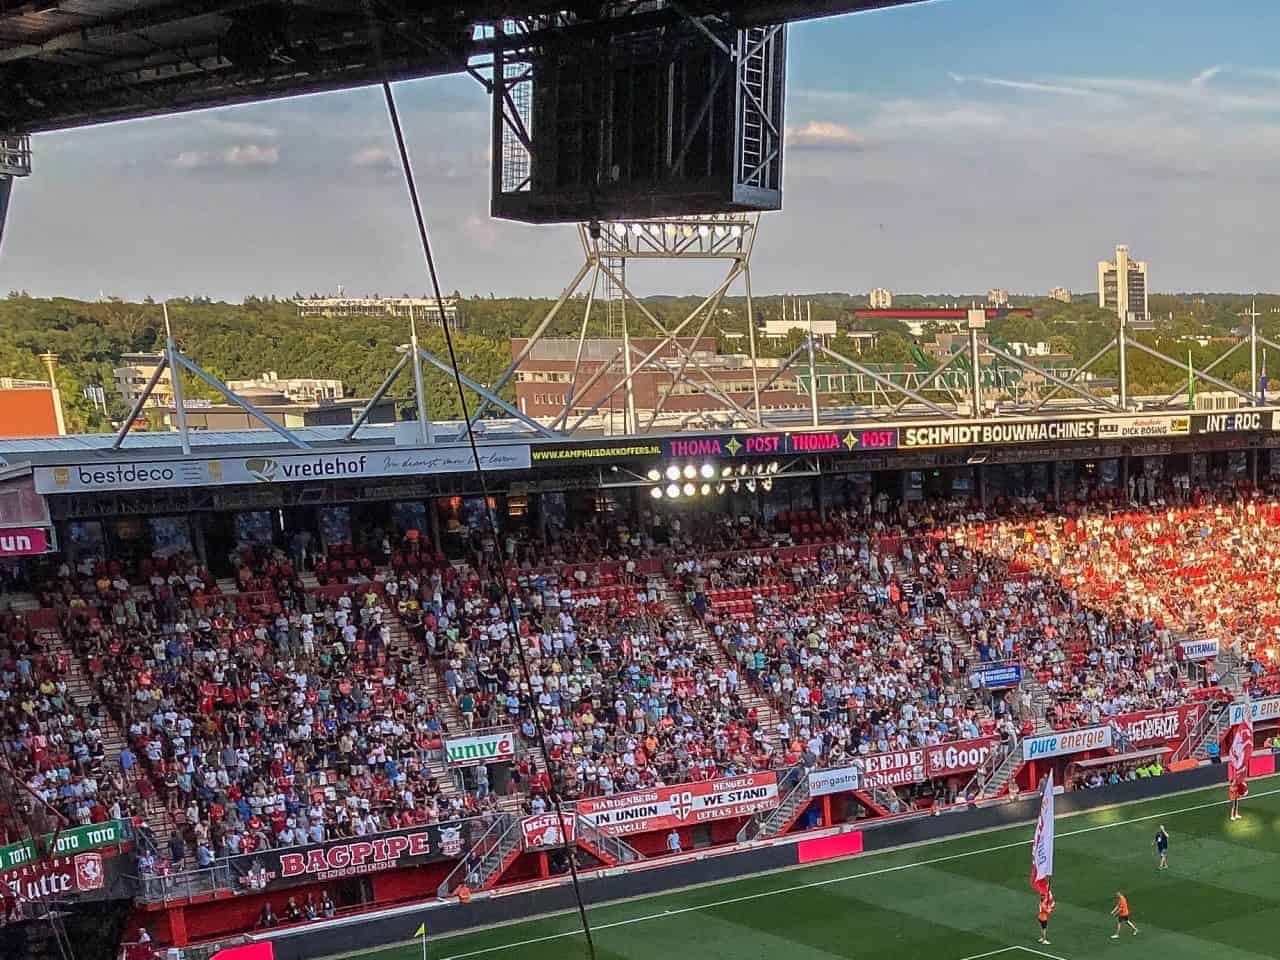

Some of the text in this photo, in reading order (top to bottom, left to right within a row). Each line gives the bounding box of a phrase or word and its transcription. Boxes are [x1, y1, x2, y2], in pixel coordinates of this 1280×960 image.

[791, 430, 893, 452] THOMA POST
[905, 425, 981, 446] SCHMIDT
[983, 420, 1095, 443] BOUWMACHINES
[669, 436, 779, 458] THOMA POST
[79, 463, 174, 485] bestdeco
[281, 456, 367, 478] vredehof
[1234, 704, 1258, 720] pue
[1030, 729, 1105, 758] pure energie
[856, 751, 923, 773] EEDE
[945, 745, 990, 768] Goor
[596, 787, 768, 826] IN UNION WE STAND
[87, 827, 115, 844] TOTO
[280, 831, 431, 878] BAGPIPE
